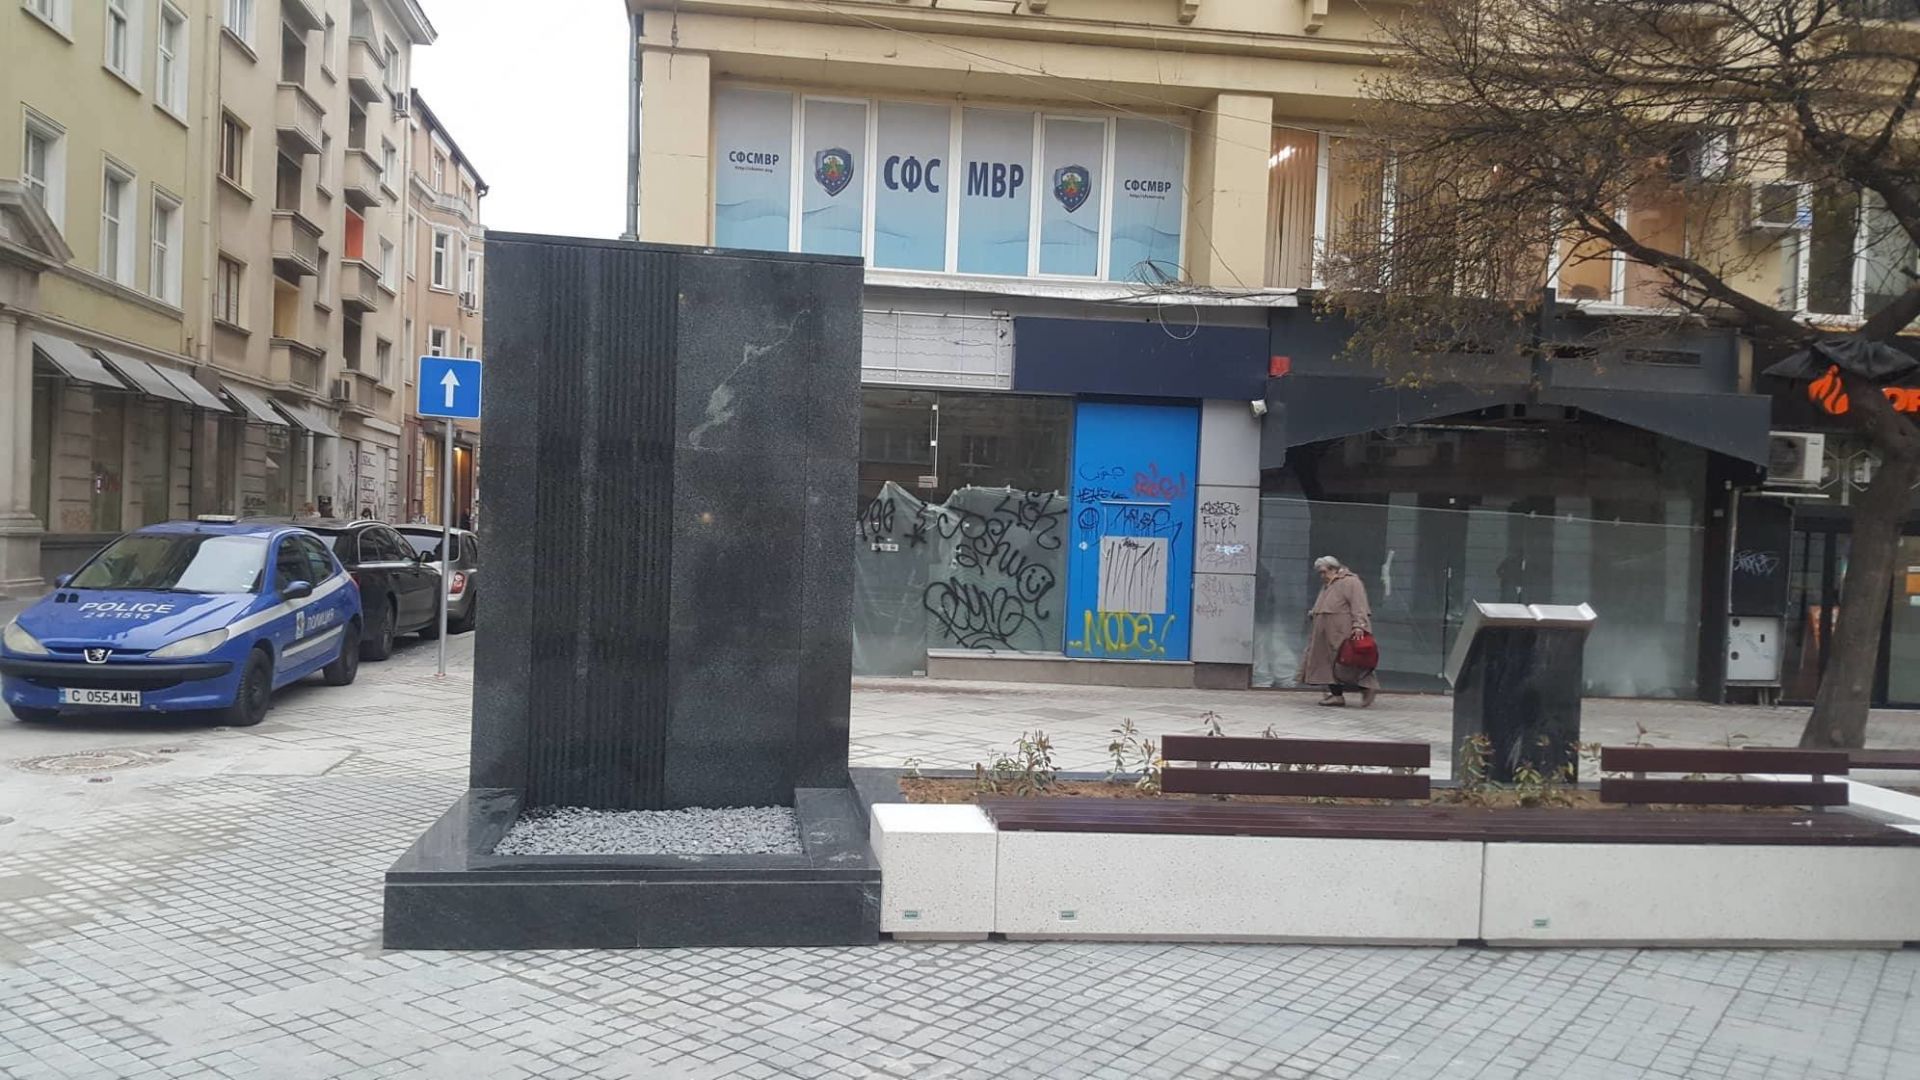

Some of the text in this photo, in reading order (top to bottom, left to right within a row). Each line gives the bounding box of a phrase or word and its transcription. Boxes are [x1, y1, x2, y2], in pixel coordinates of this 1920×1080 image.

[729, 151, 779, 165] СФСМВР
[883, 155, 1024, 199] СФС МВР
[1124, 179, 1171, 193] СФСМВР
[79, 602, 176, 614] POLICE
